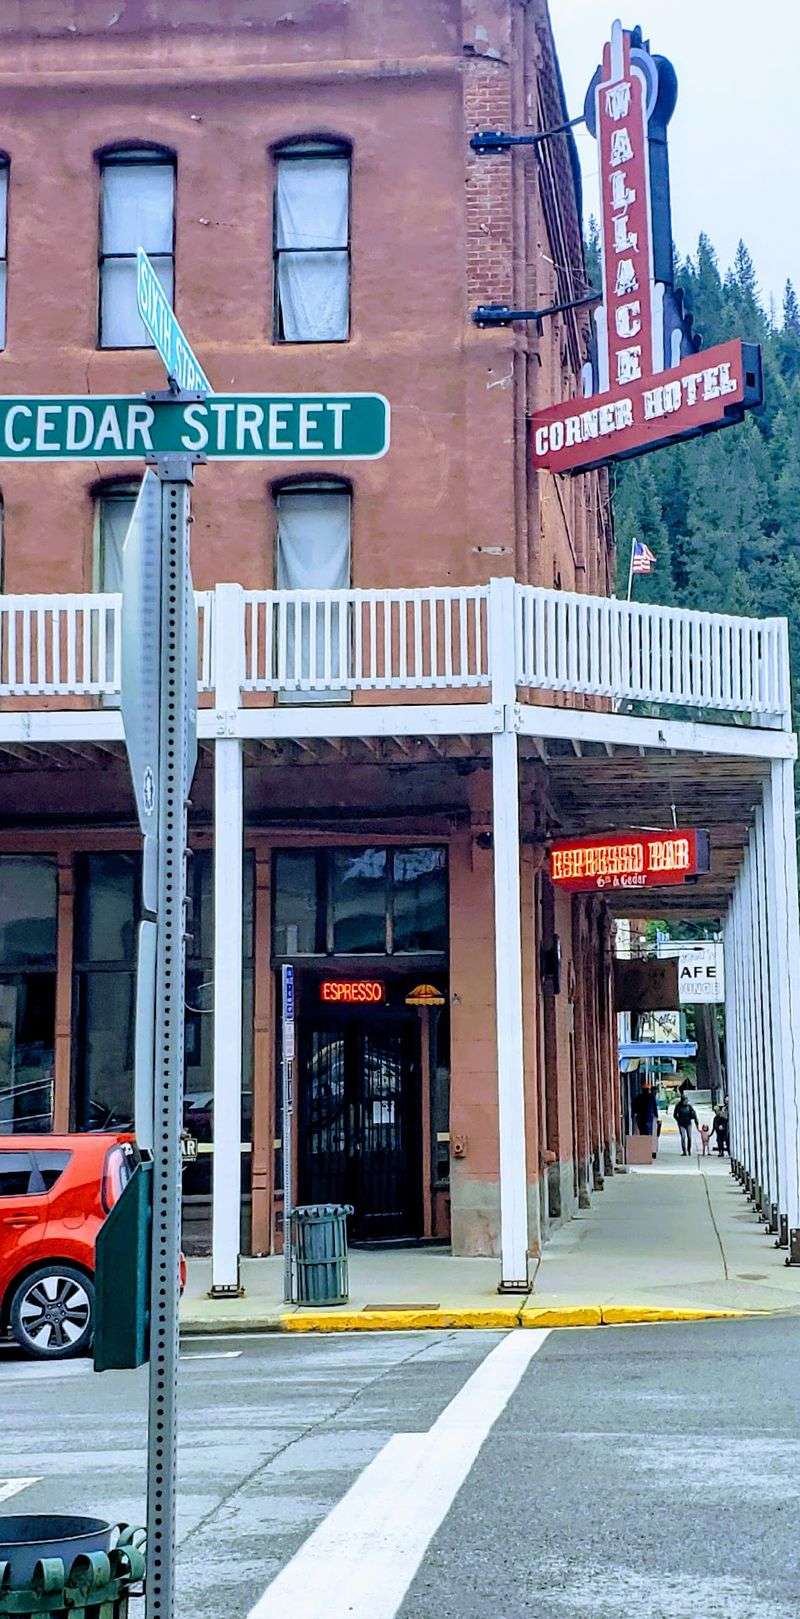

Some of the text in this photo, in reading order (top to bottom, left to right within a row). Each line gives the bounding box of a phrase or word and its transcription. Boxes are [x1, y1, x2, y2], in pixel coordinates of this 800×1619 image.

[604, 81, 641, 385] WALLACE
[141, 261, 172, 363] SIXTH
[4, 403, 351, 452] CEDAR STREET
[535, 362, 738, 456] CORNER HOTEL
[551, 838, 690, 879] ESPRESSO BAR
[620, 873, 648, 886] Cedar
[323, 982, 382, 1001] ESPRESSO
[680, 966, 717, 979] AFE
